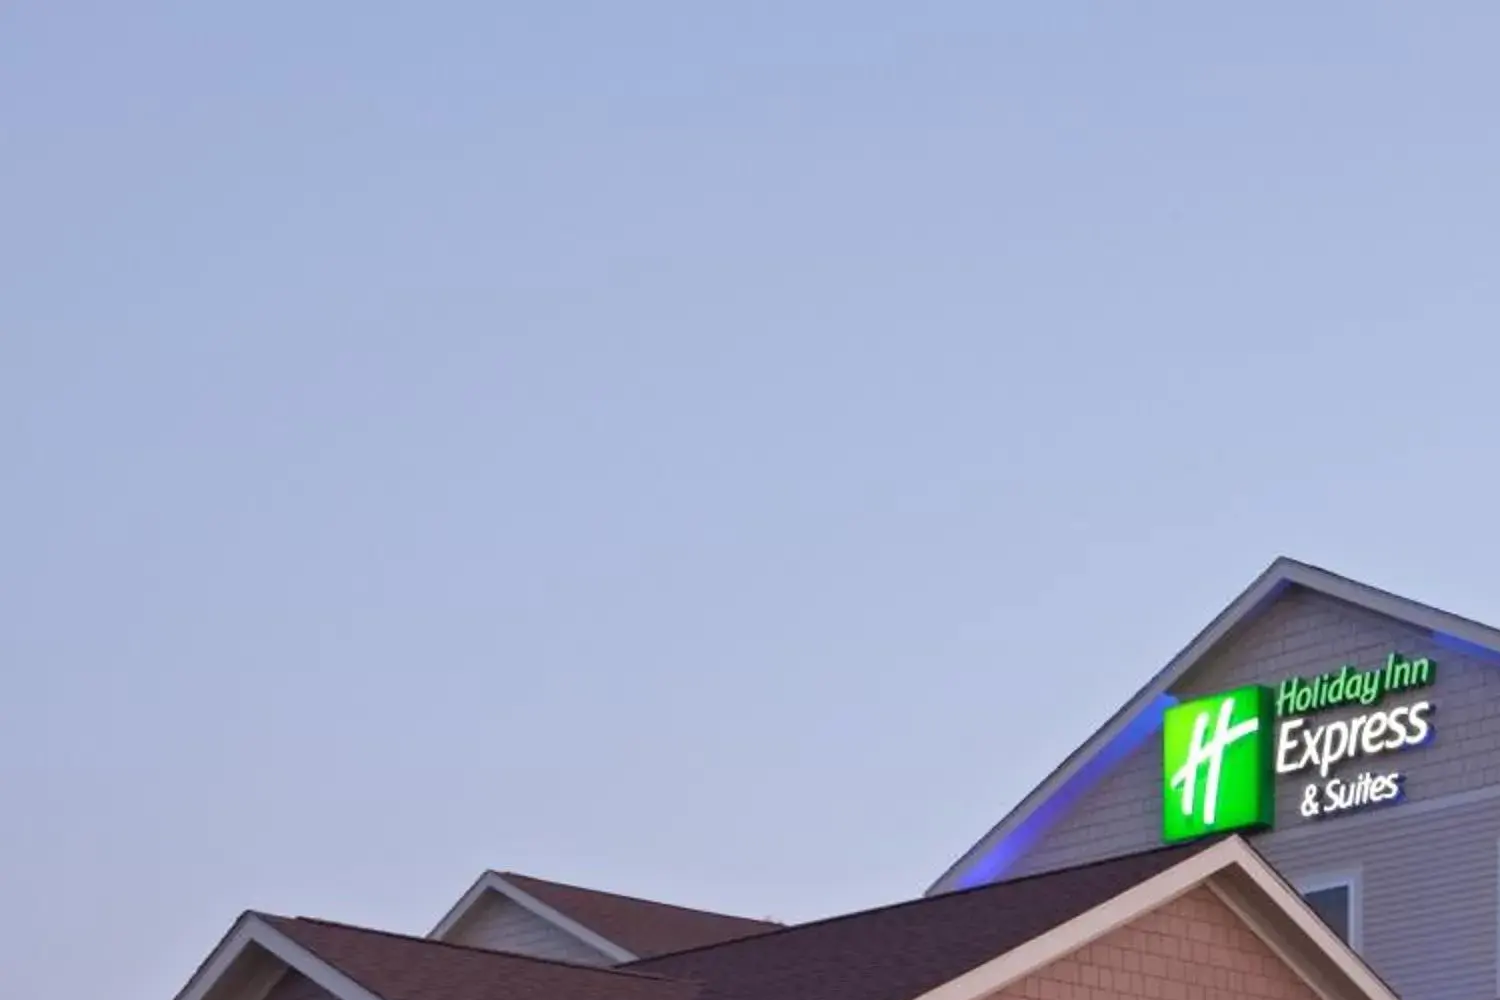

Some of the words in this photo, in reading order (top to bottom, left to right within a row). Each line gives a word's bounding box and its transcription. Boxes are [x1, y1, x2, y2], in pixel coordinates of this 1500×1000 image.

[1276, 665, 1381, 717] Holiday
[1384, 652, 1429, 690] Inn
[1276, 701, 1430, 777] Express
[1300, 783, 1319, 816] &
[1323, 771, 1399, 812] Suites
